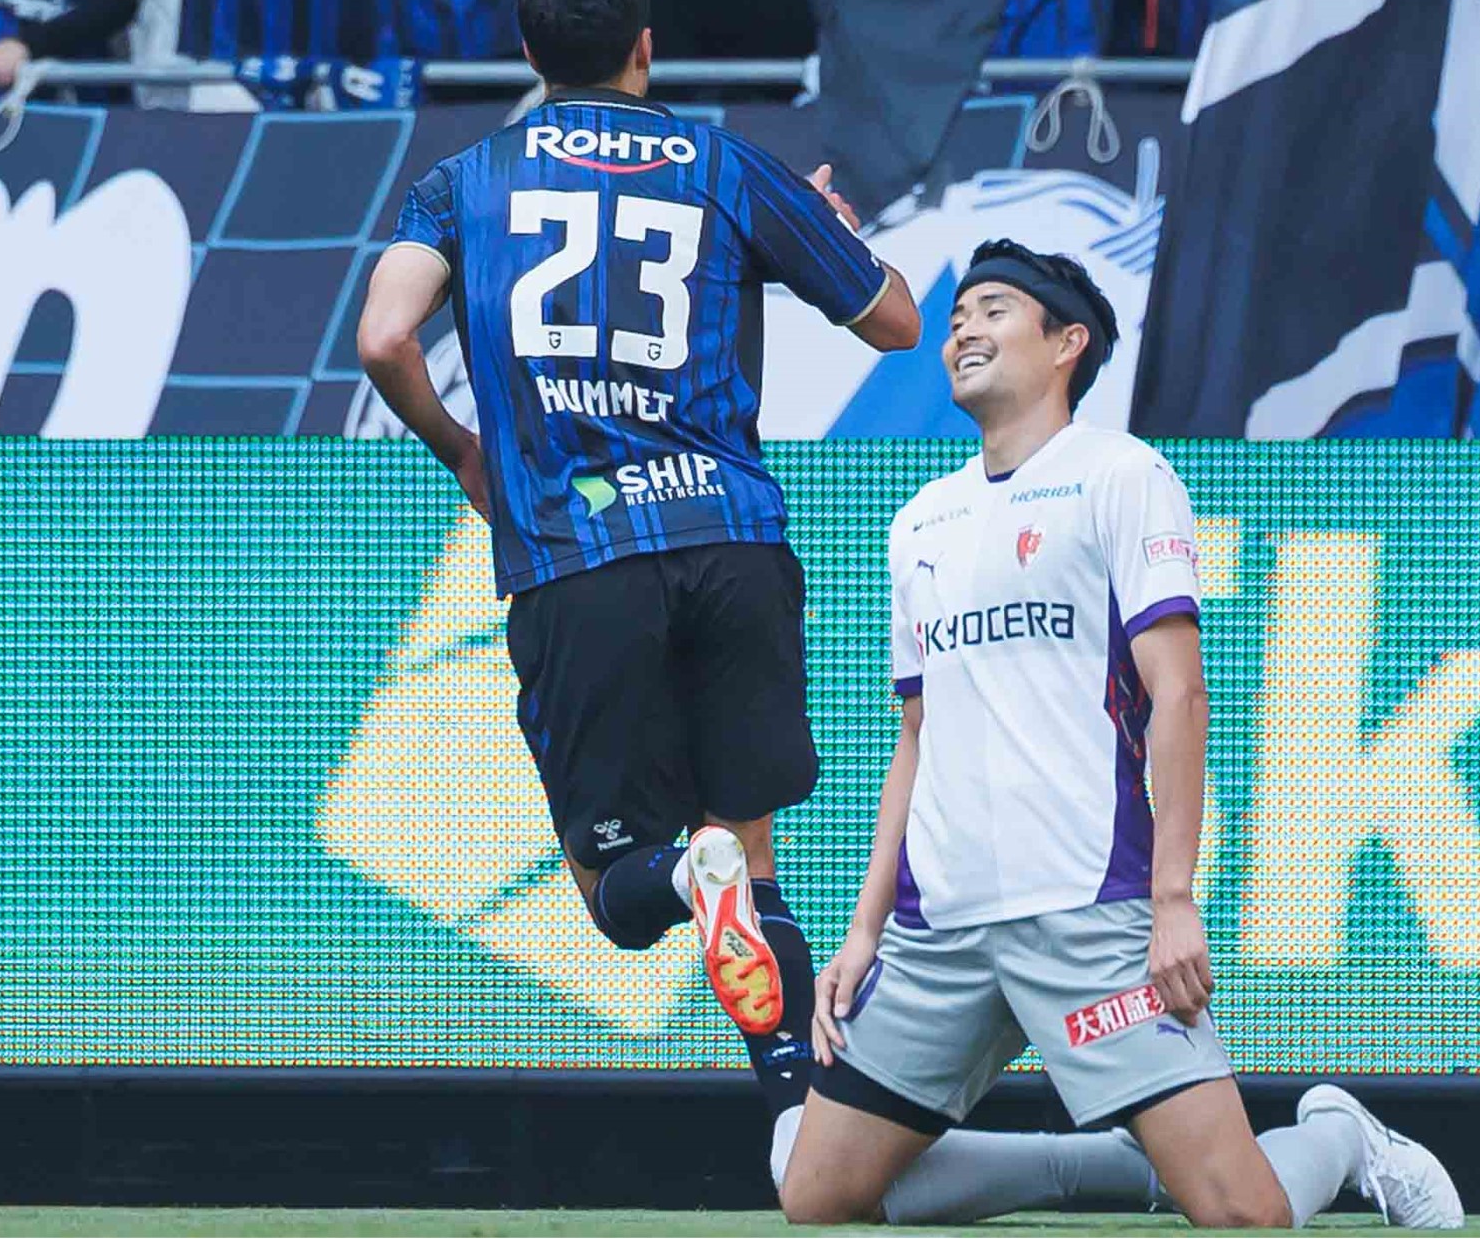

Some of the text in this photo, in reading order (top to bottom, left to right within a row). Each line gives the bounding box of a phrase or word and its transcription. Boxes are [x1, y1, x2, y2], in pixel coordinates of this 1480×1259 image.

[525, 125, 697, 165] ROHTO
[510, 189, 706, 370] 23
[535, 374, 675, 422] HUMMET
[616, 452, 718, 494] SHIP
[625, 483, 727, 507] HEALTHCARE
